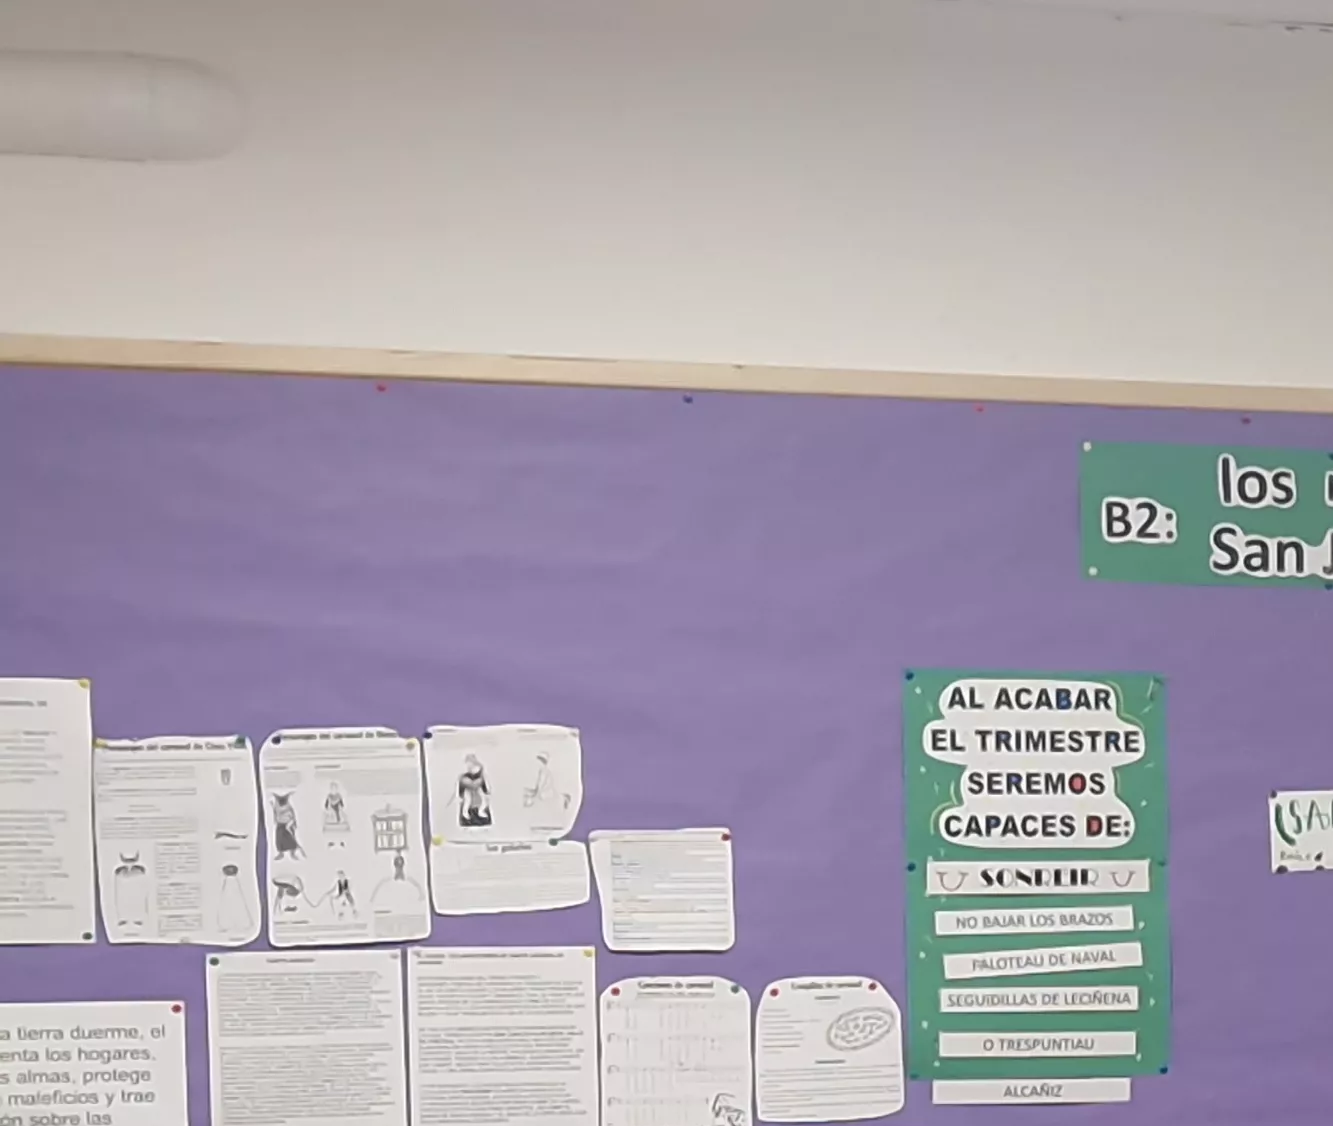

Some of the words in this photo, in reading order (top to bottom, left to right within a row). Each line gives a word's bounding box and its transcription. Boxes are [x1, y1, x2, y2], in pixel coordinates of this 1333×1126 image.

[1220, 456, 1294, 505] los
[1104, 501, 1176, 539] B2:
[1212, 527, 1305, 573] San
[949, 686, 985, 710] AL
[994, 687, 1112, 710] ACABAR
[930, 728, 966, 752] EL
[975, 729, 1141, 753] TRIMESTRE
[967, 772, 1106, 795] SEREMOS
[944, 815, 1076, 838] CAPACES
[1085, 816, 1131, 838] DE:
[956, 916, 978, 930] NO
[983, 914, 1025, 928] BAJAR
[1029, 914, 1056, 926] LOS
[1060, 912, 1114, 925] BRAZOS
[972, 955, 1044, 971] PALOTEAU
[1049, 953, 1067, 967] DE
[1071, 949, 1117, 964] NAVAL
[947, 993, 1038, 1007] SEGUIDILLAS
[1042, 993, 1060, 1006] DE
[1064, 990, 1132, 1005] LECIÑENA
[17, 1027, 64, 1041] tierra
[70, 1026, 145, 1041] duerme,
[150, 1025, 167, 1039] el
[983, 1038, 995, 1052] O
[999, 1037, 1096, 1051] TRESPUNTIAU
[45, 1049, 72, 1062] los
[83, 1068, 153, 1086] protege
[8, 1090, 100, 1107] maleficios
[105, 1091, 116, 1108] y
[121, 1089, 157, 1103] trae
[1003, 1083, 1064, 1098] ALCAÑIZ
[30, 1114, 81, 1126] sobre
[86, 1111, 113, 1126] las
